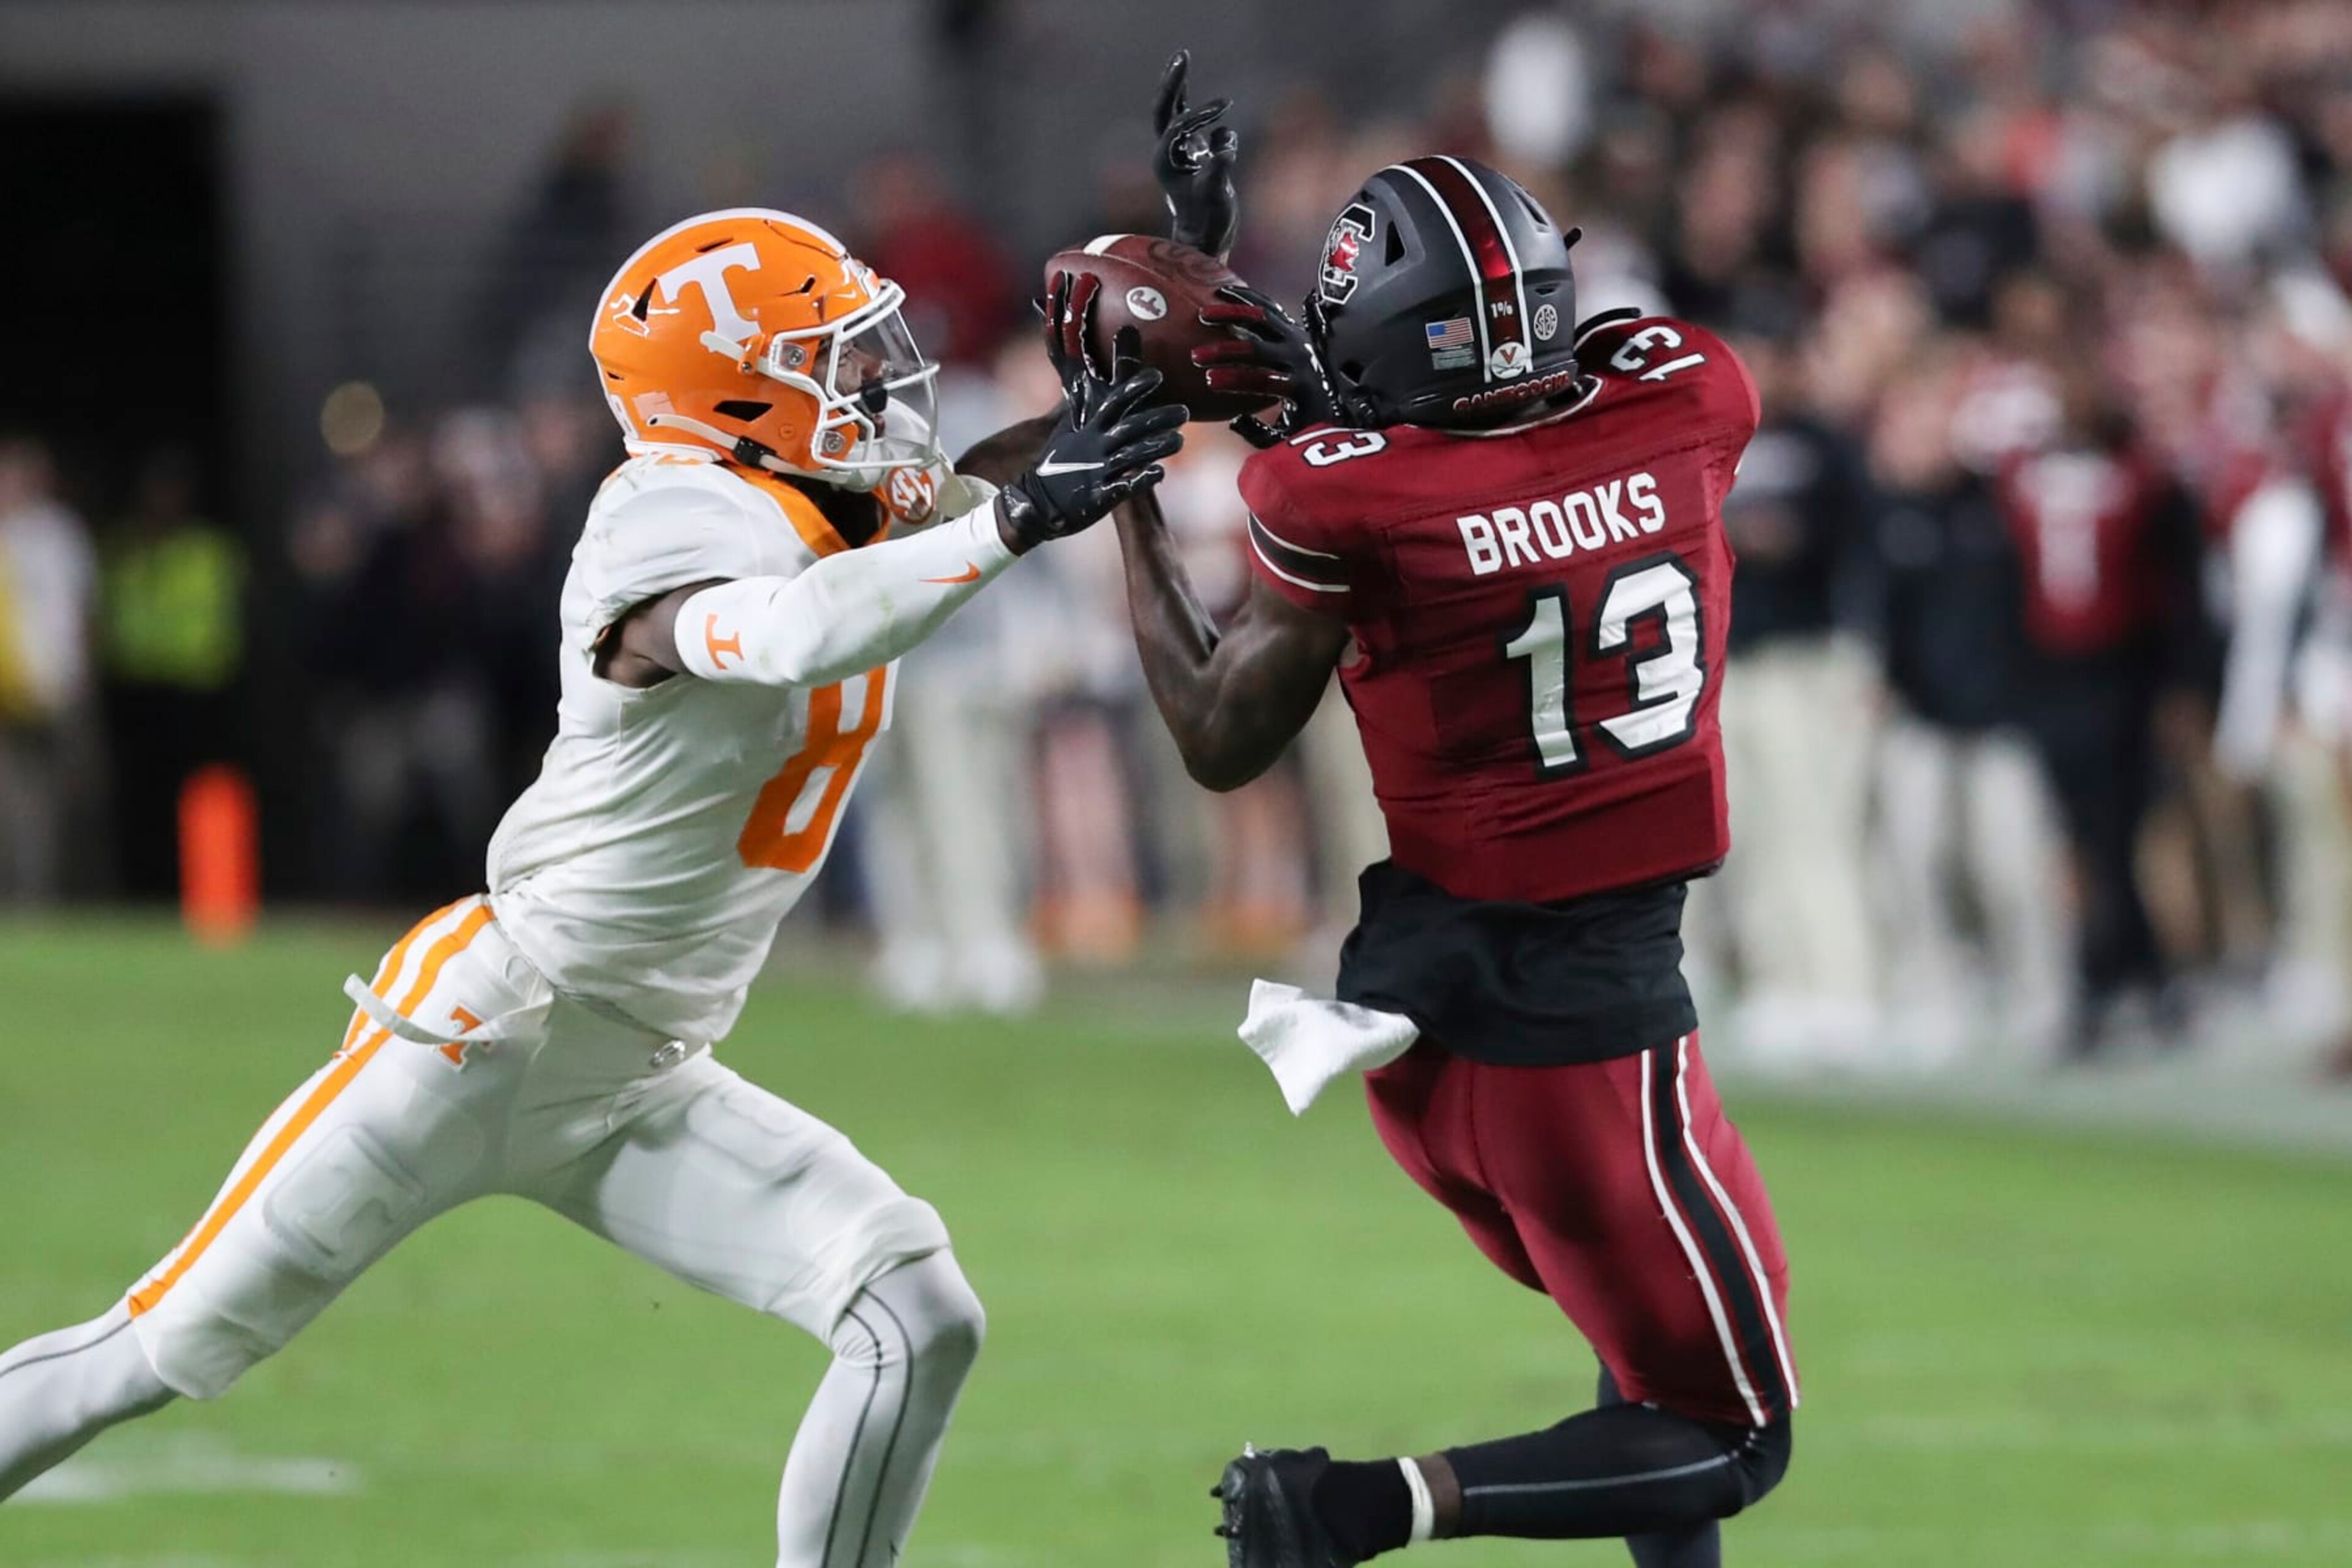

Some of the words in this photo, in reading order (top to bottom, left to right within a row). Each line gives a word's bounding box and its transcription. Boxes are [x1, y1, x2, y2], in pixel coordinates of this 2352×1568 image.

[657, 243, 762, 343] T
[1491, 301, 1513, 318] 1%
[1499, 346, 1517, 364] V
[1610, 326, 1705, 381] 13
[1457, 472, 1665, 576] BROOKS
[706, 614, 745, 670] T
[1506, 562, 1704, 768] 13
[737, 665, 887, 872] 8
